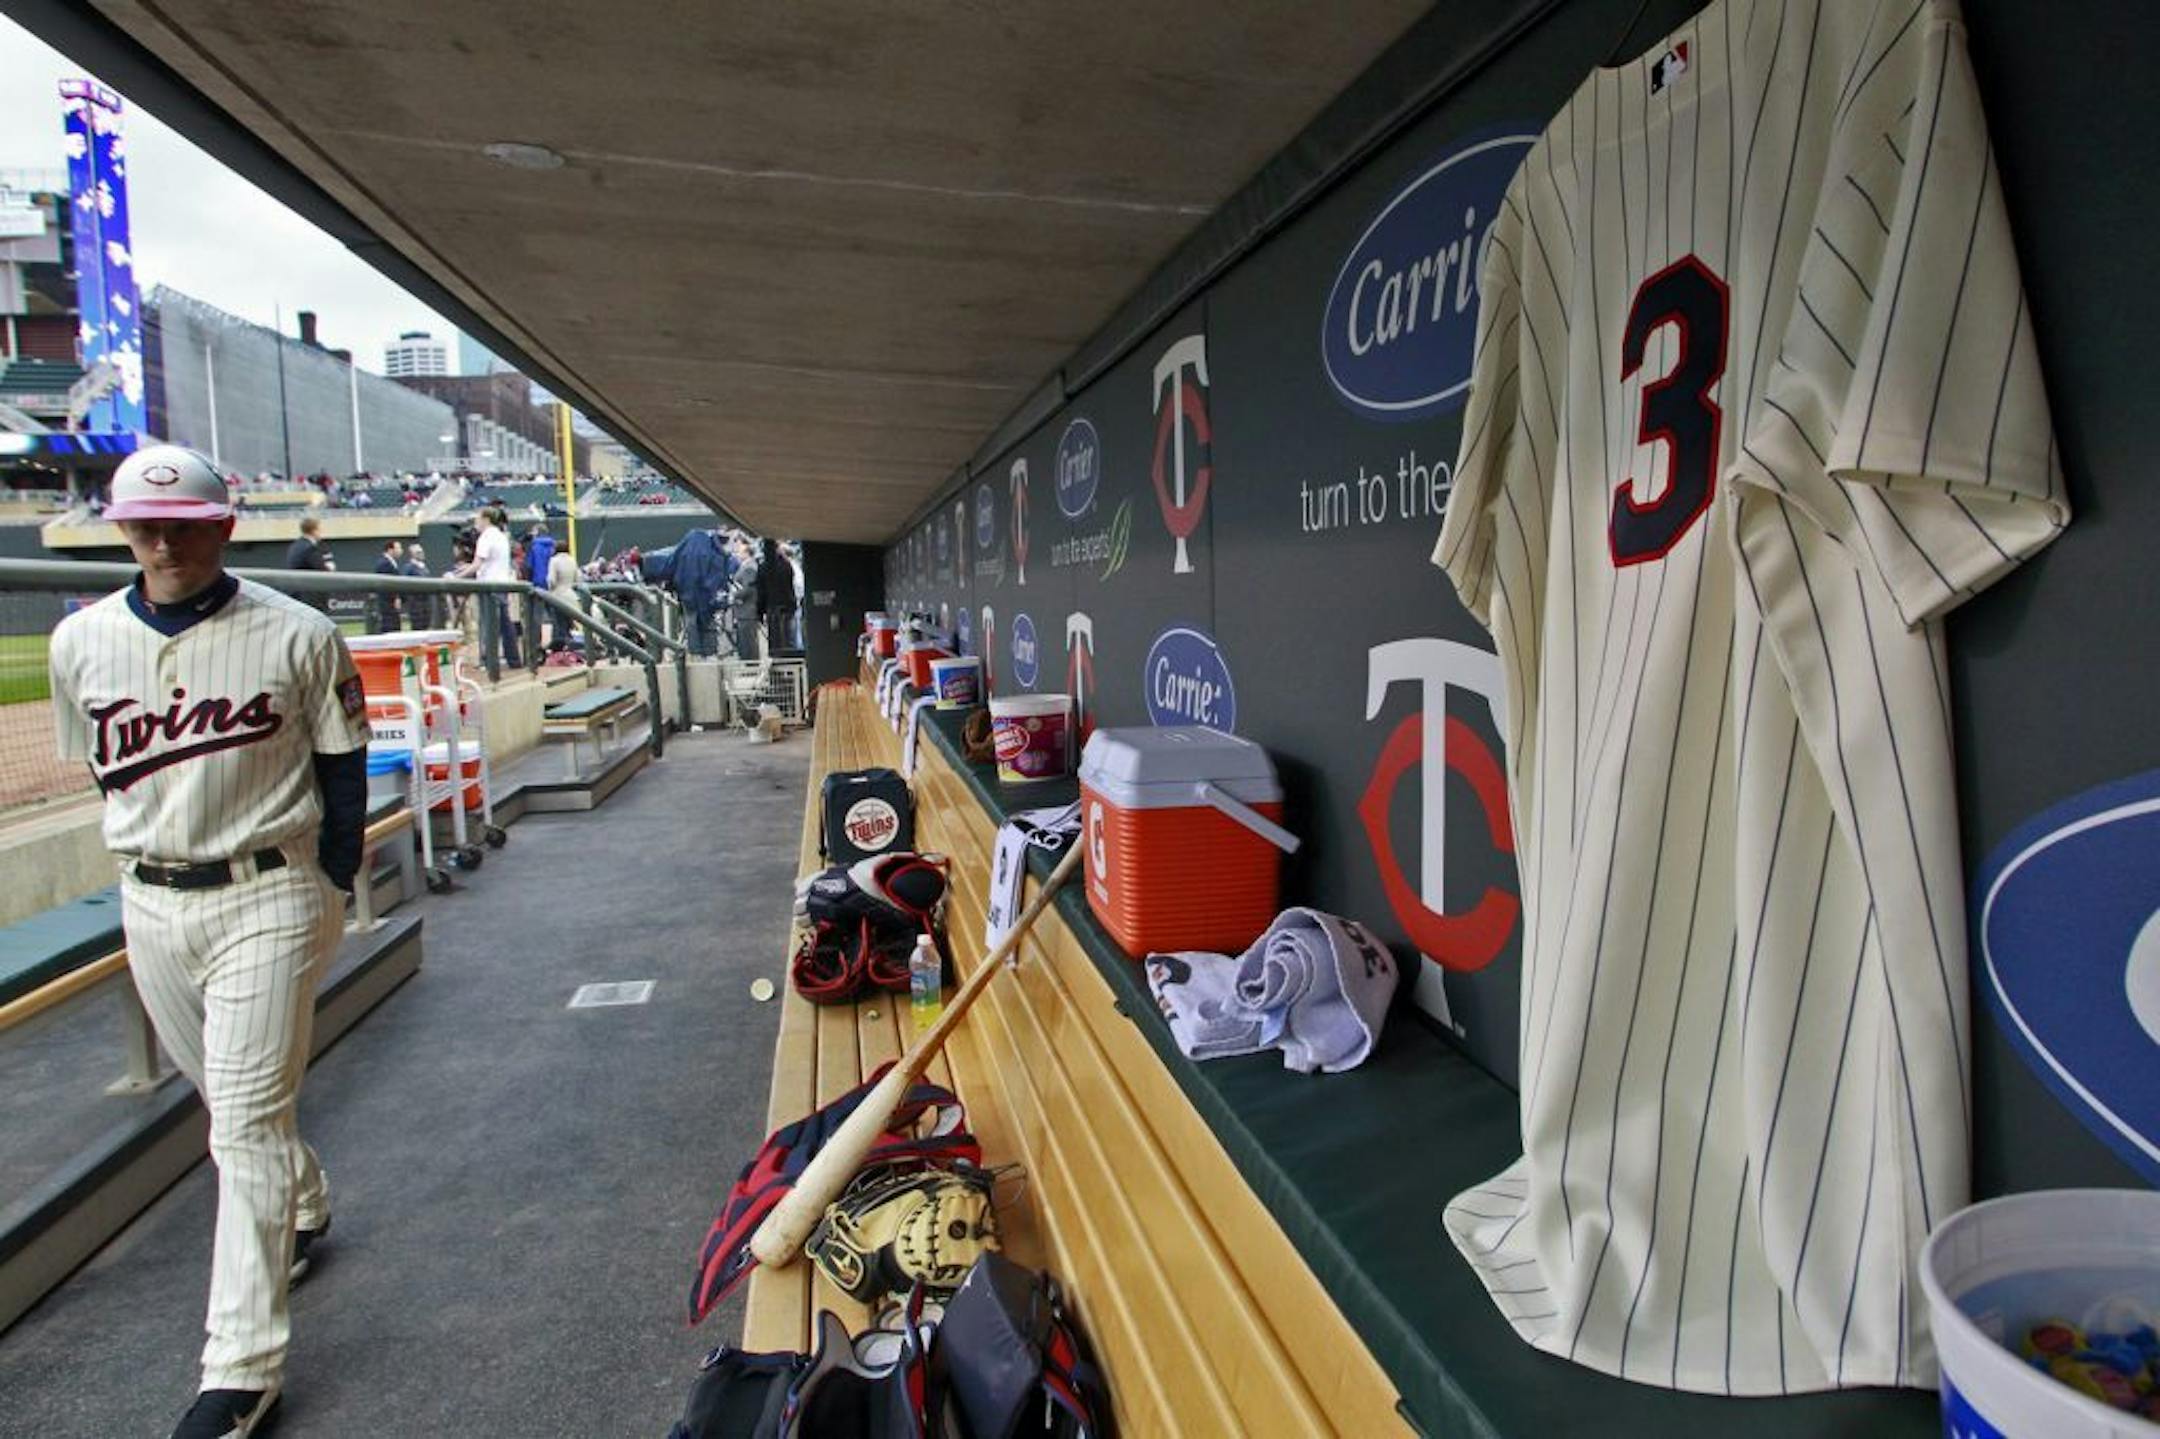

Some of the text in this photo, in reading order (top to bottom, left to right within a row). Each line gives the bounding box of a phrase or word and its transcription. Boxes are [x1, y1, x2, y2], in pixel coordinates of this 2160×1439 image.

[1607, 253, 1731, 568] 3
[1301, 449, 1453, 533] turn to the
[89, 688, 282, 768] Twins
[848, 815, 895, 842] Twins
